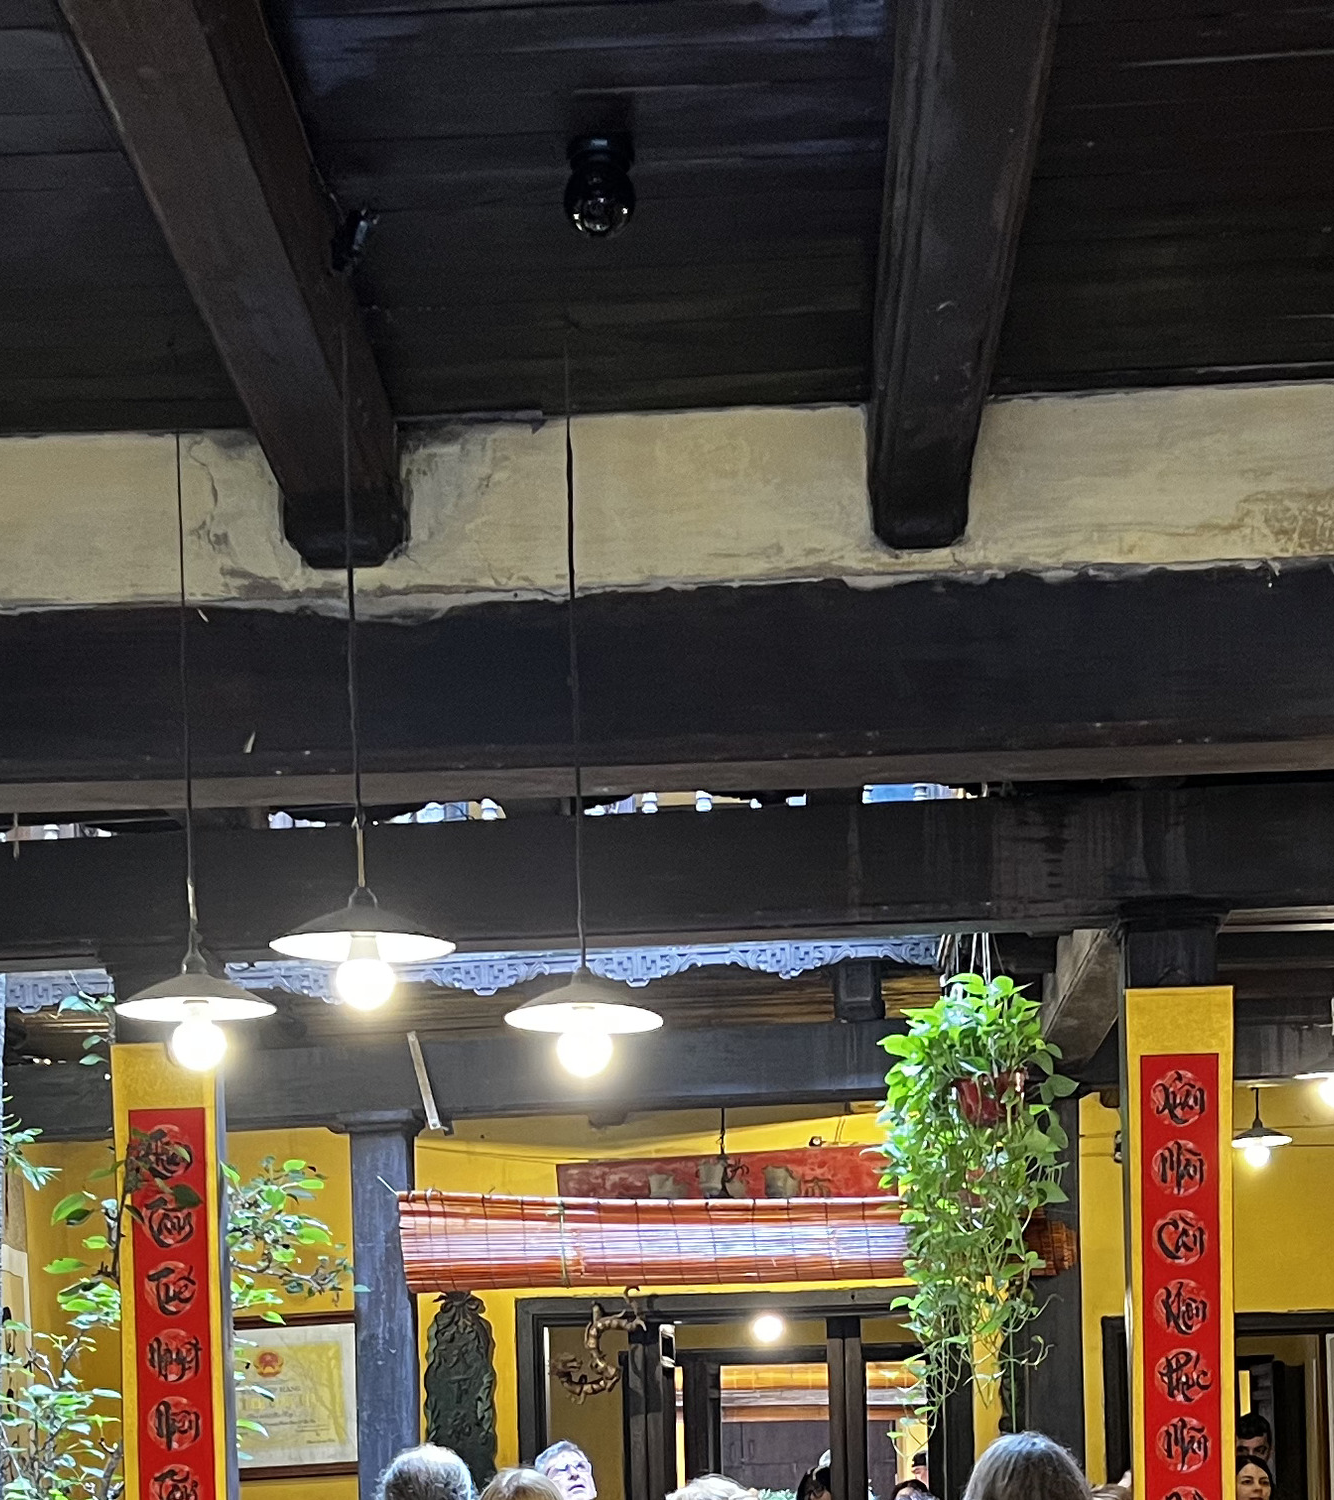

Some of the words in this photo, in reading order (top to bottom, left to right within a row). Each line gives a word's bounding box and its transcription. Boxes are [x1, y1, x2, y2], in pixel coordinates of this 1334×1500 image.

[1153, 1070, 1206, 1125] Xuân
[1157, 1213, 1206, 1260] Càn
[147, 1265, 197, 1316] Tuế
[1160, 1281, 1207, 1335] Khôn
[1158, 1351, 1213, 1402] Phúc
[1166, 1417, 1209, 1472] Mãn
